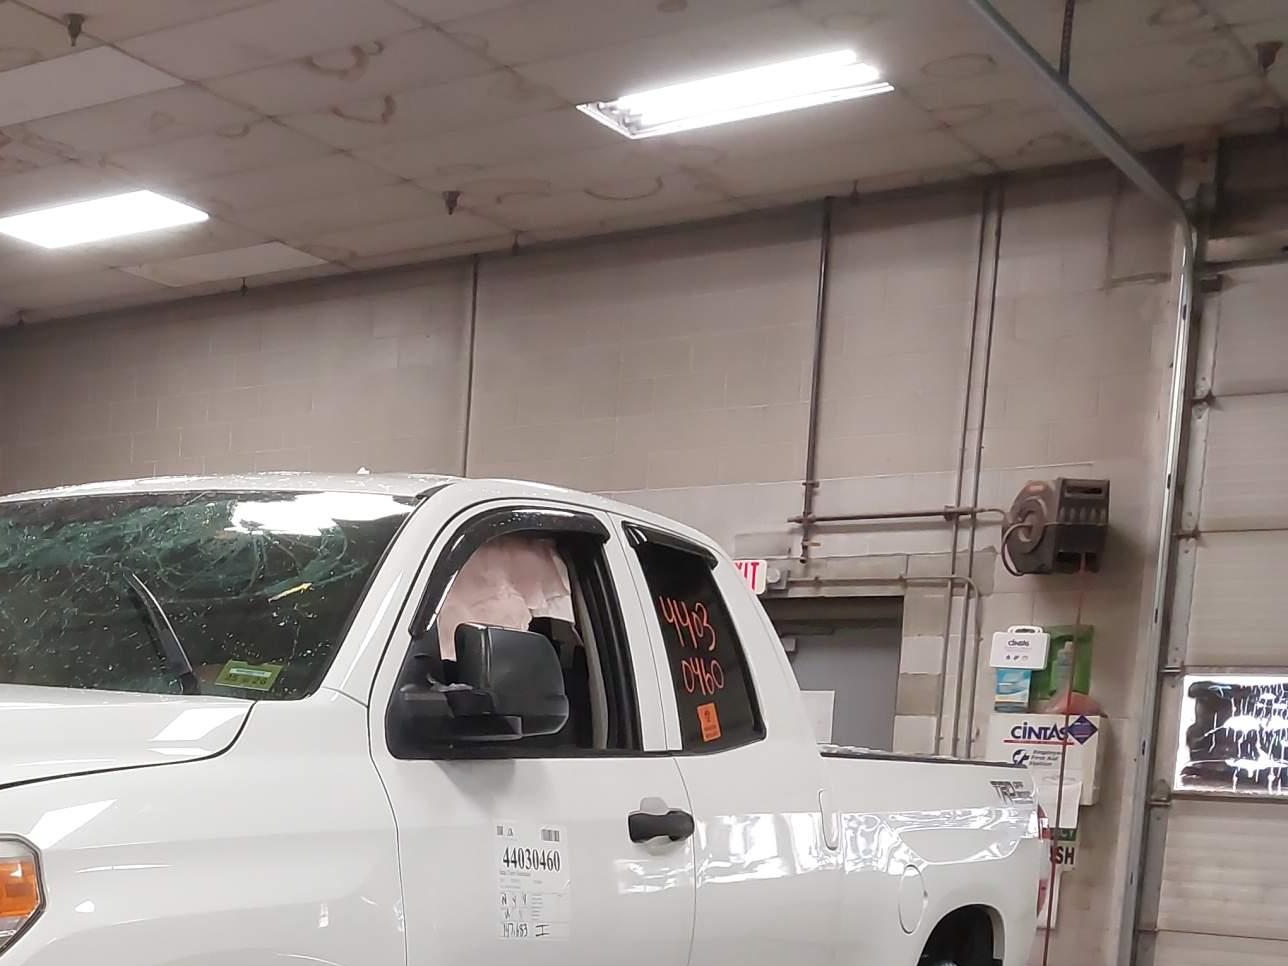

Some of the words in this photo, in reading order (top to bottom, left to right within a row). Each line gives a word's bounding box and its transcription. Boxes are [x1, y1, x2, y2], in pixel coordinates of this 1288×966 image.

[735, 561, 760, 591] IT
[659, 596, 716, 651] 4403
[682, 657, 725, 696] 0460
[503, 847, 560, 872] 44030460
[1049, 845, 1075, 865] SH
